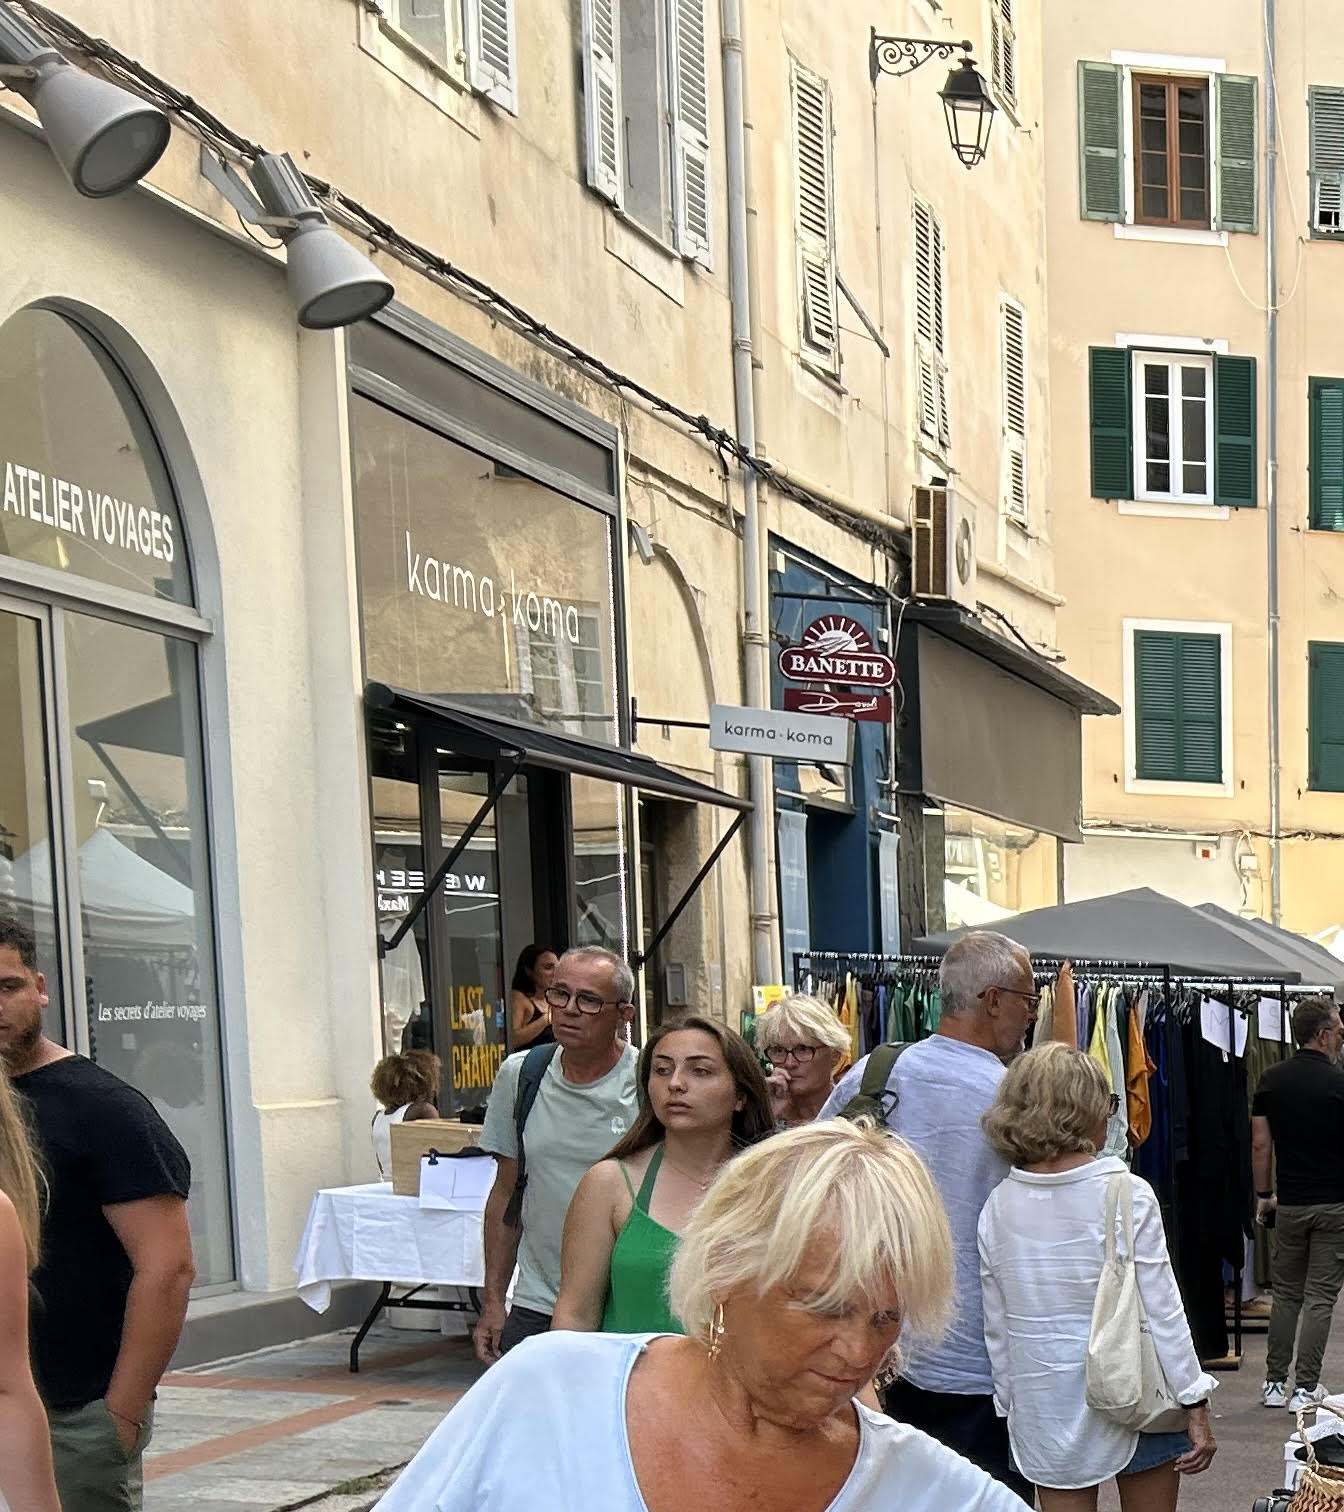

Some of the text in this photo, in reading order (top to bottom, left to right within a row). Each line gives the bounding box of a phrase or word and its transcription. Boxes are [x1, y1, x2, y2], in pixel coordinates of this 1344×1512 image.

[4, 462, 174, 562] ATELIER VOYAGES
[406, 530, 580, 643] karma koma
[790, 654, 884, 678] BANETTE
[725, 721, 833, 745] karma koma
[98, 1000, 207, 1022] Les secrets d'atelier voyages
